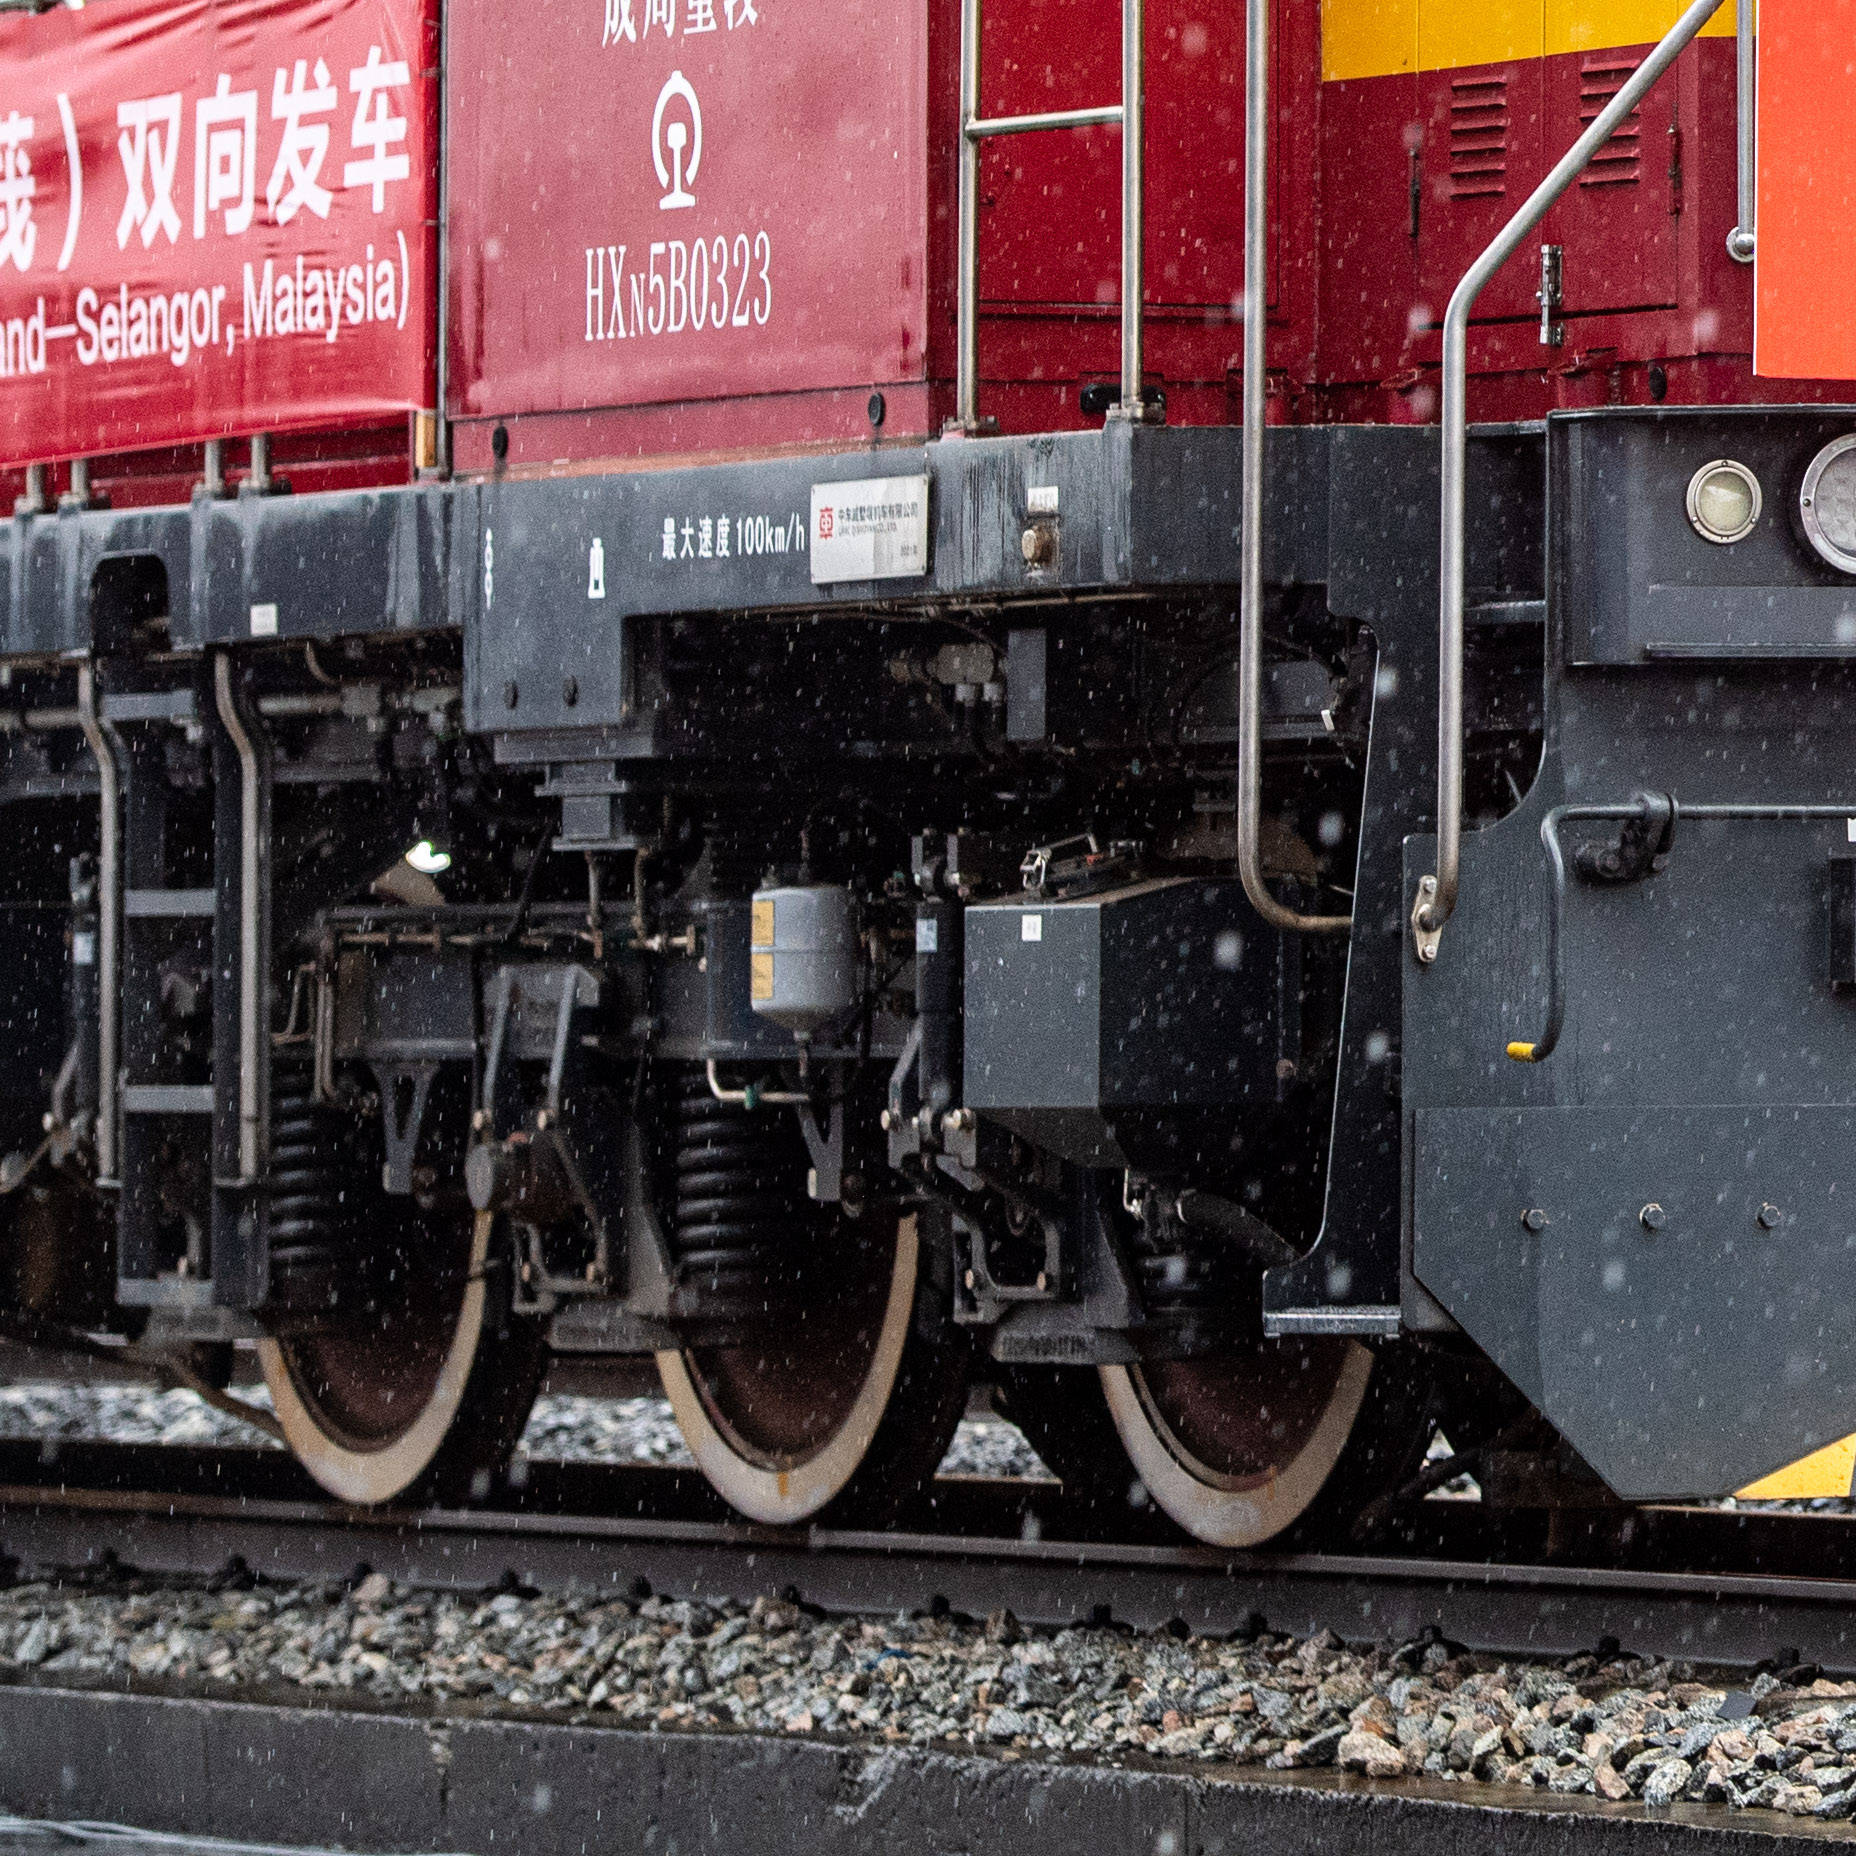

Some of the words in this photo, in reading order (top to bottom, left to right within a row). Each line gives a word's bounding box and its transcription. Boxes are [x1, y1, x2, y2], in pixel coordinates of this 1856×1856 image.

[243, 229, 410, 344] Malaysia)
[584, 231, 773, 342] HXN5B0323
[662, 514, 731, 561] 最大速度
[736, 512, 806, 556] 100km/h
